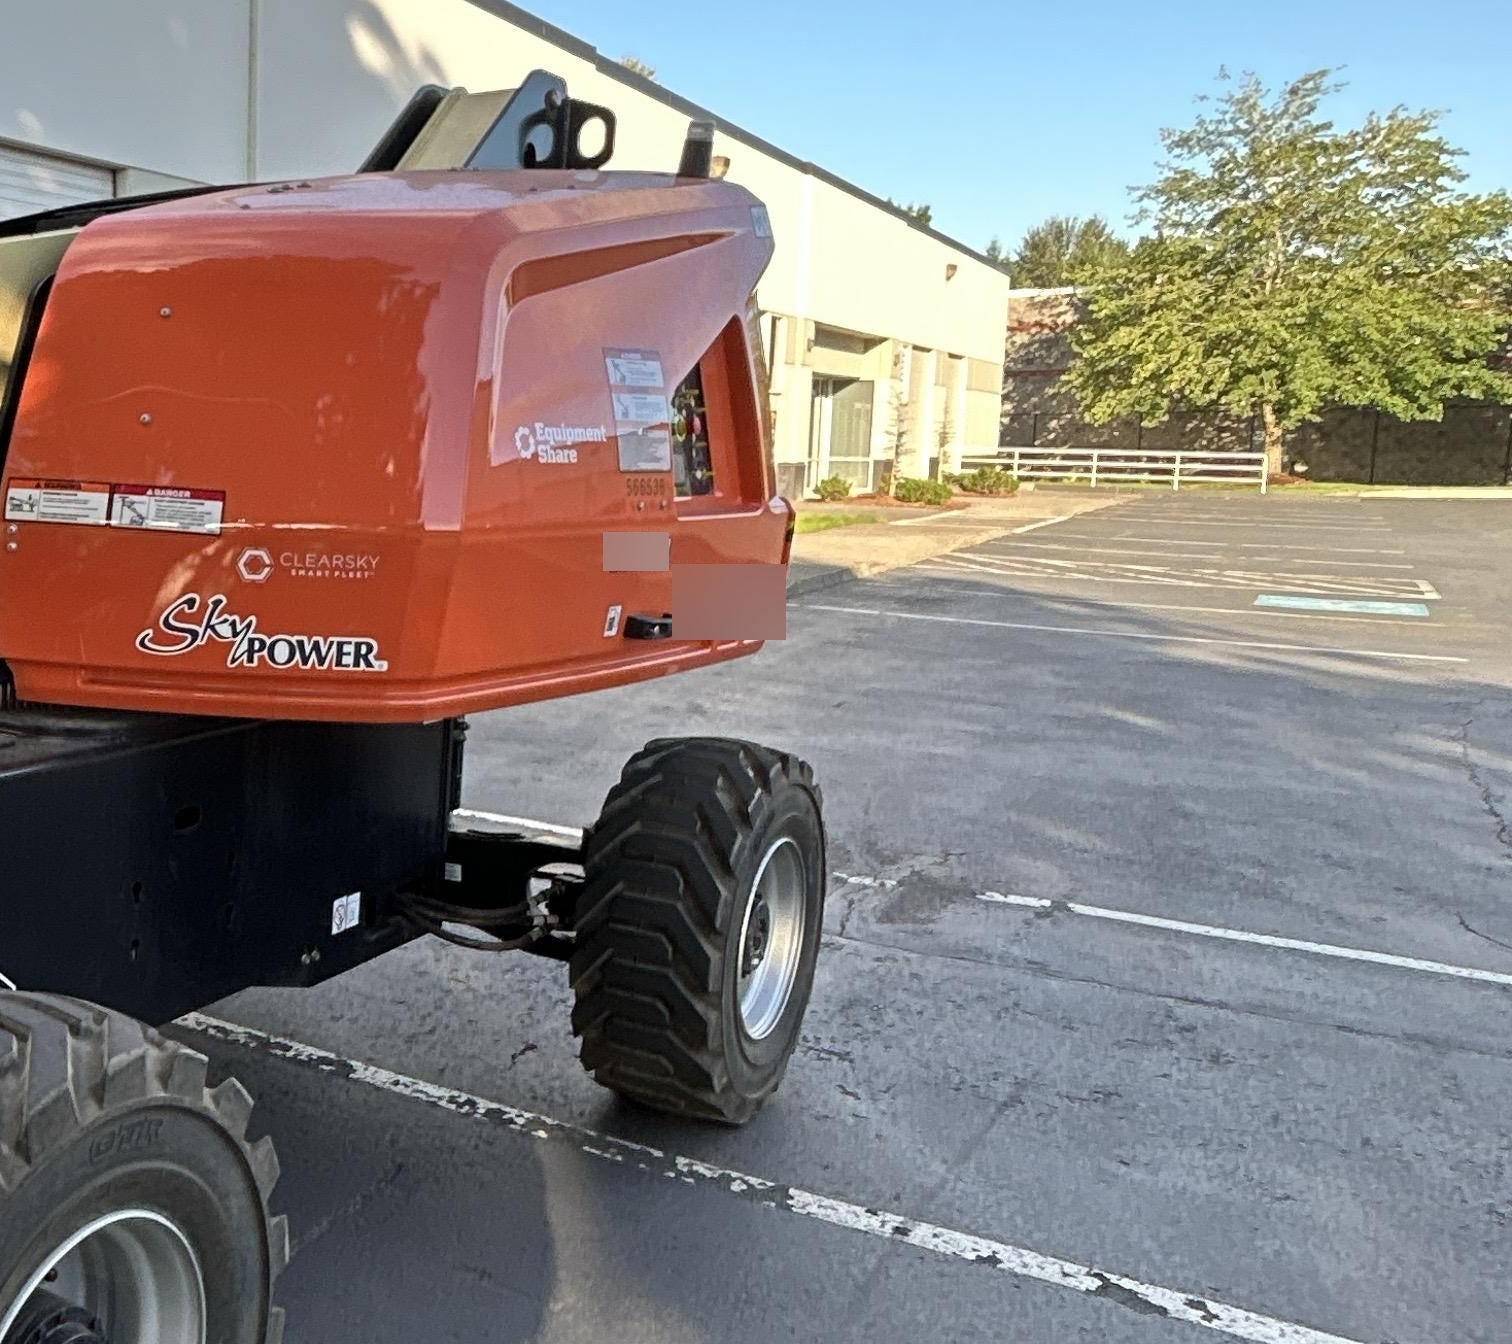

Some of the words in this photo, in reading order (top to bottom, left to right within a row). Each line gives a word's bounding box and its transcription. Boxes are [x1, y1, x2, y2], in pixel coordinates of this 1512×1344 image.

[534, 422, 607, 446] Equipment
[538, 444, 578, 464] Share
[279, 552, 380, 570] CLEARSKY
[291, 568, 330, 578] SMART
